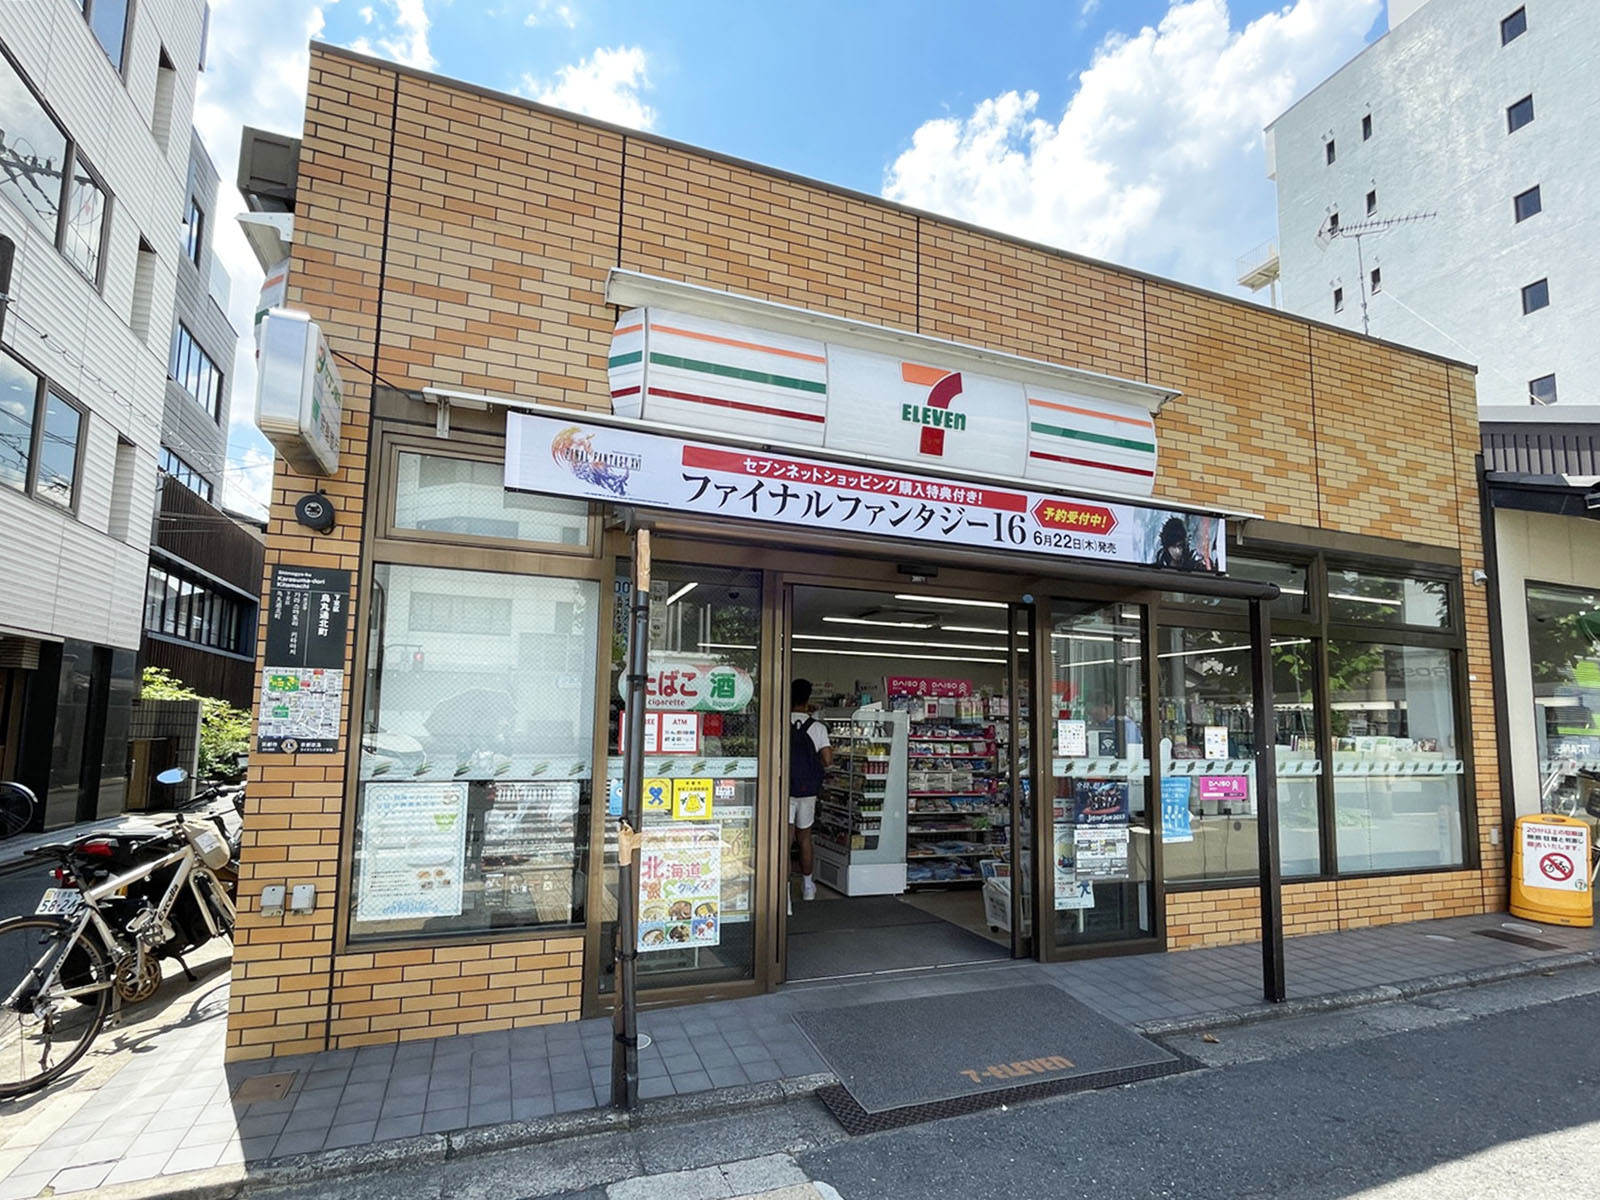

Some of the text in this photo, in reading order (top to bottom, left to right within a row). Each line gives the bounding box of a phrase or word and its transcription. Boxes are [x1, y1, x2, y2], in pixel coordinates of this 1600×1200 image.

[1043, 507, 1108, 529] 予約受付中!
[710, 672, 736, 698] 酒
[641, 855, 701, 880] 北海道
